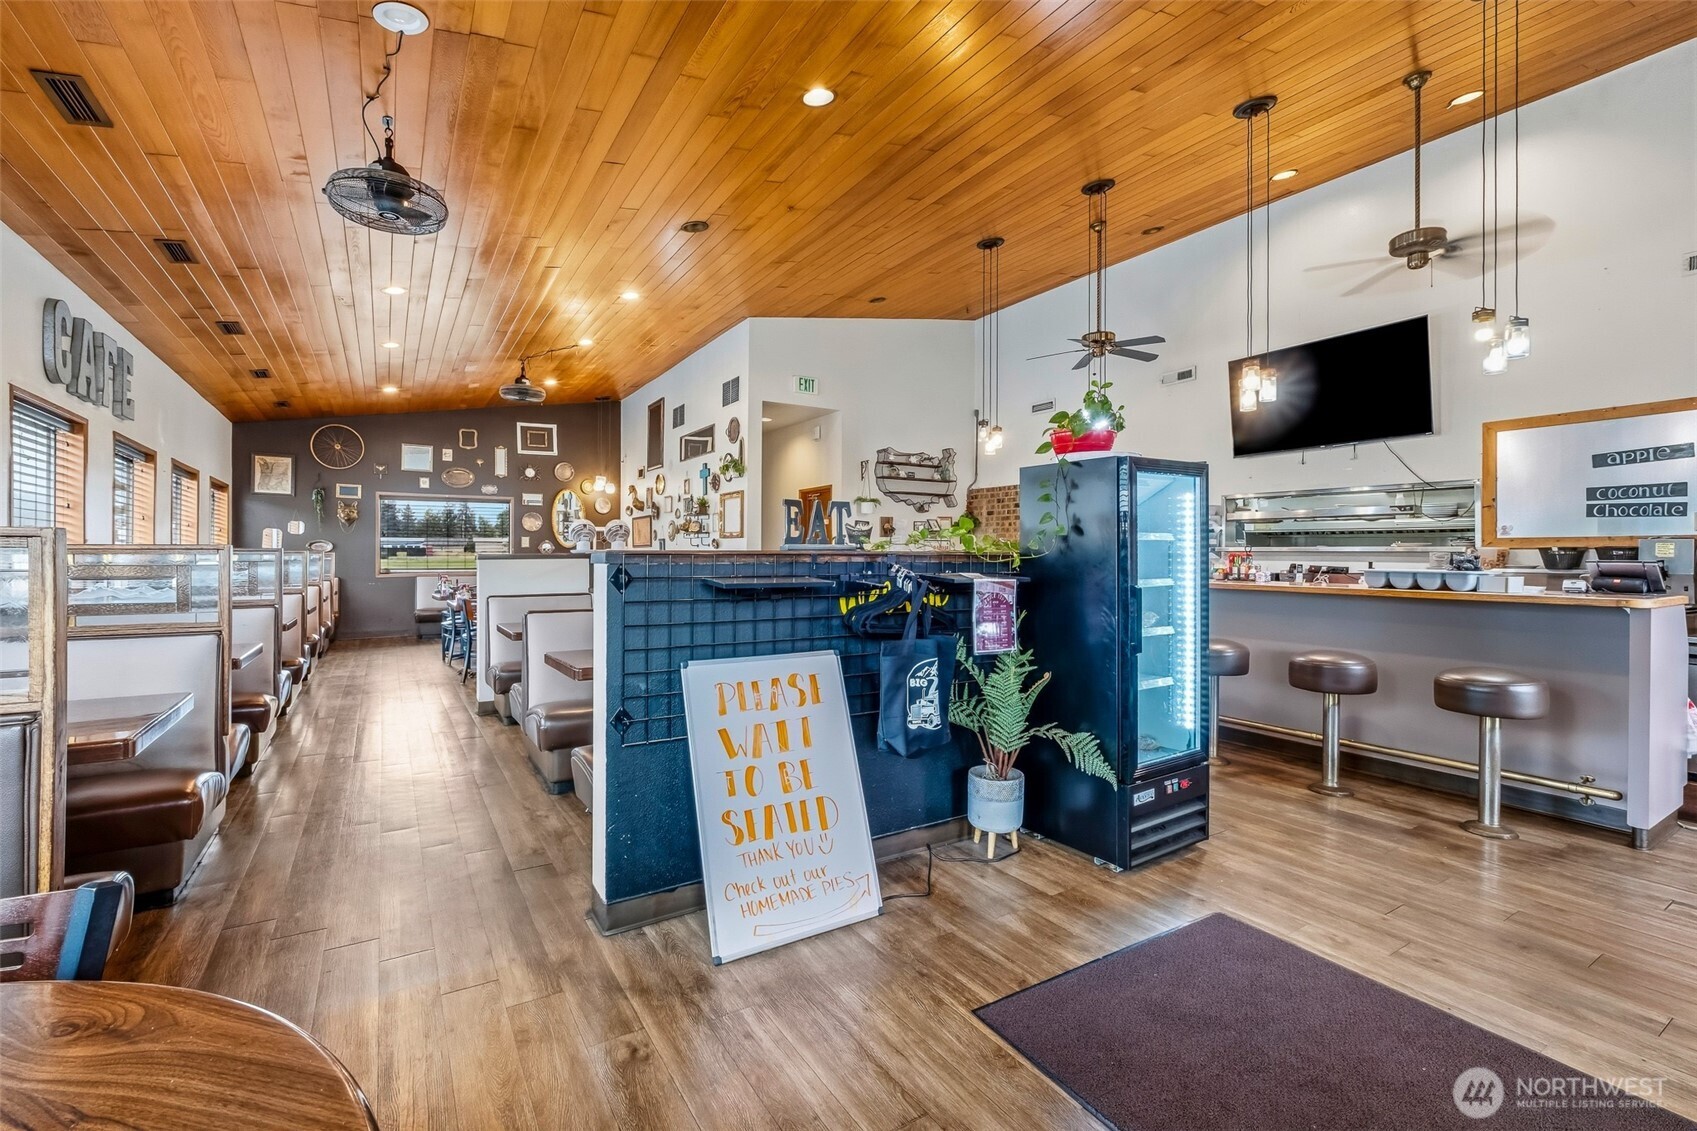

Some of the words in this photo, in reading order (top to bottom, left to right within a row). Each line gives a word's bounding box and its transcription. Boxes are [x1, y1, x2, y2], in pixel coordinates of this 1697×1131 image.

[42, 298, 135, 421] CAFE
[798, 377, 815, 393] EXIT
[1606, 446, 1671, 465] apple
[782, 498, 852, 545] EAT
[714, 672, 823, 716] PLEASE
[909, 678, 928, 688] BIG
[717, 716, 813, 759] WAIT
[716, 765, 764, 797] TO
[777, 758, 818, 794] BE
[721, 795, 839, 847] SEATED
[736, 842, 784, 869] THANK
[785, 838, 816, 856] YOU
[724, 872, 767, 902] Check
[773, 868, 798, 890] out
[803, 864, 828, 882] our
[740, 884, 817, 919] HOMEMADE
[822, 871, 857, 893] PIES
